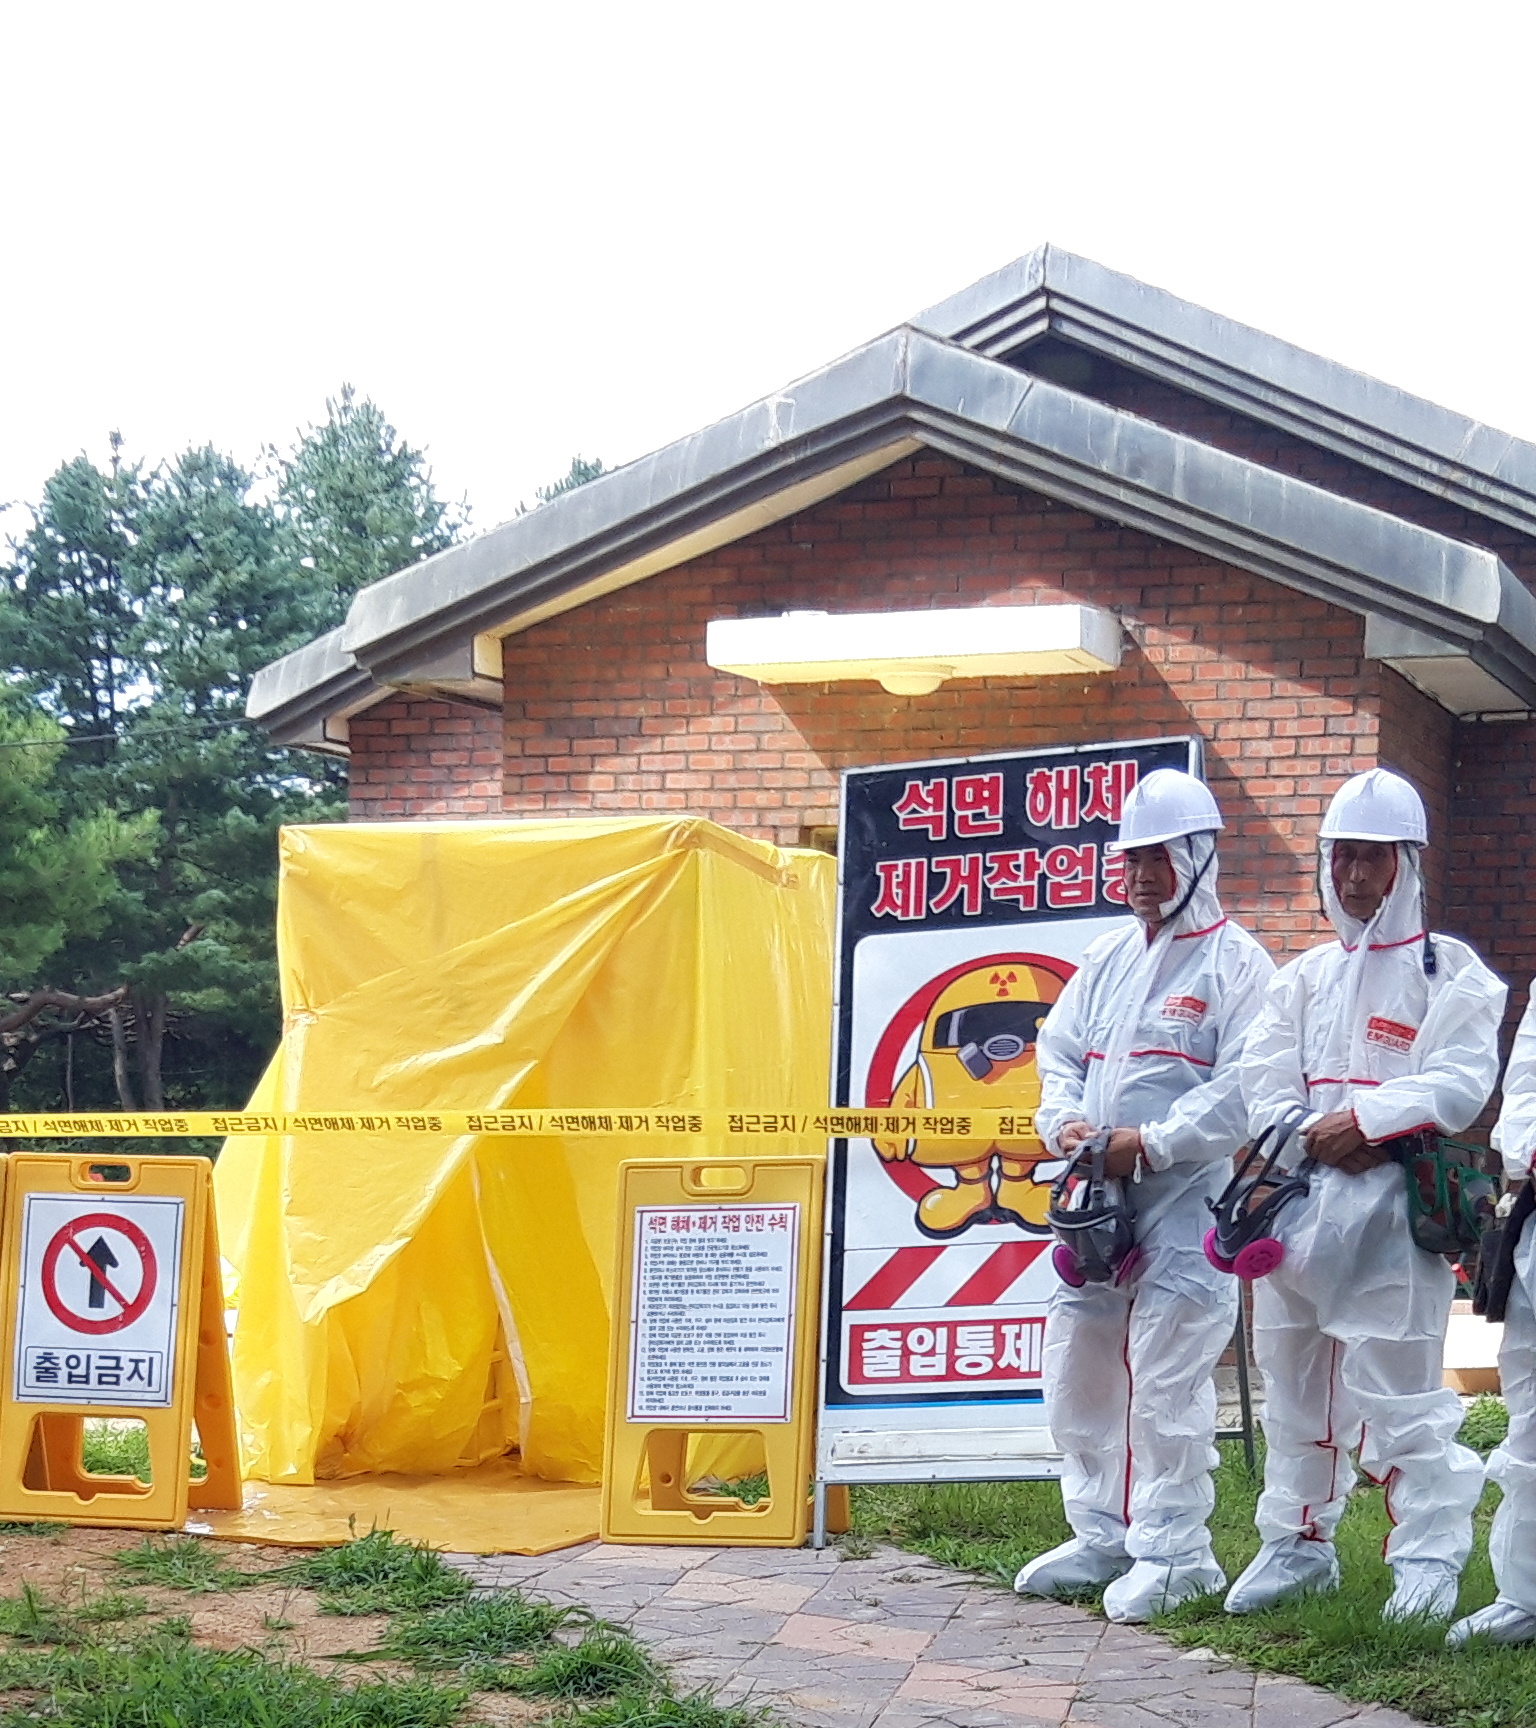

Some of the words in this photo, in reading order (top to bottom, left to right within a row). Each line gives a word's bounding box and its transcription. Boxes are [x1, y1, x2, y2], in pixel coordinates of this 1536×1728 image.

[893, 778, 1005, 841] 석면
[1026, 760, 1139, 829] 해체
[142, 1118, 189, 1133] 작업중
[211, 1117, 278, 1132] 접근금지
[395, 1116, 443, 1132] 작업중
[466, 1115, 534, 1132] 접근금지
[654, 1114, 703, 1132] 작업중
[727, 1114, 796, 1133] 접근금지
[922, 1116, 972, 1135] 작업중
[998, 1116, 1038, 1136] 접근
[647, 1214, 667, 1235] 석면
[721, 1212, 742, 1234] 작업
[744, 1213, 765, 1233] 안전
[767, 1211, 789, 1233] 수칙
[861, 1322, 1043, 1379] 출입통제
[33, 1351, 155, 1388] 출입금지
